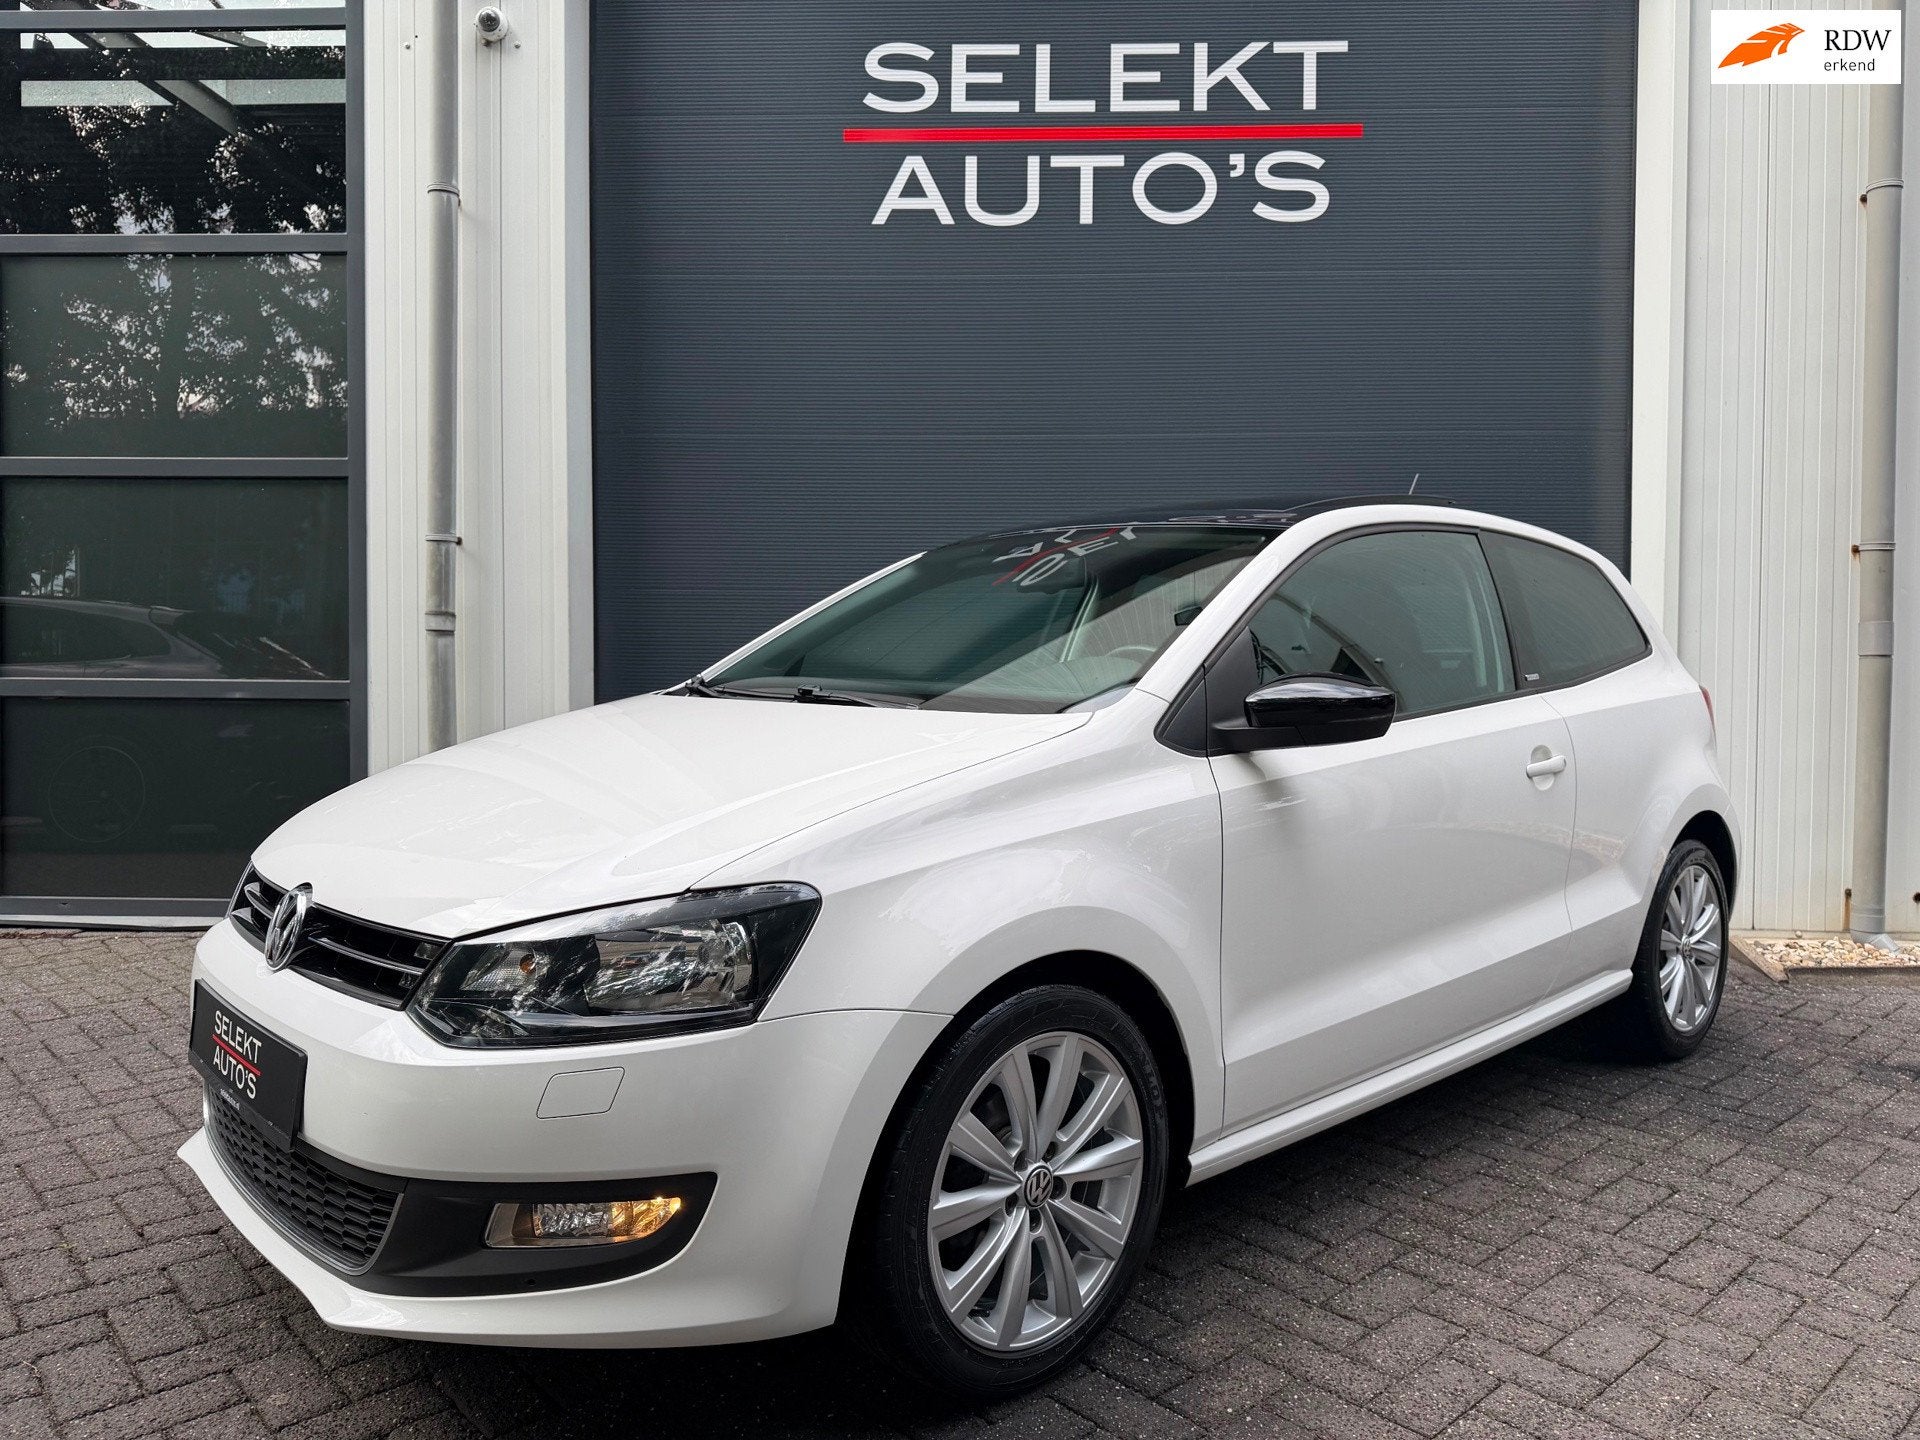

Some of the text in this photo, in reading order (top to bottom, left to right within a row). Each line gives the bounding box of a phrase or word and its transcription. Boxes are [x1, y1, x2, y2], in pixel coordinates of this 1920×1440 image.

[862, 40, 1349, 113] SELEKT
[871, 150, 1330, 227] AUTO'S
[214, 1010, 262, 1064] SELEKT
[212, 1045, 257, 1100] AUTO'S
